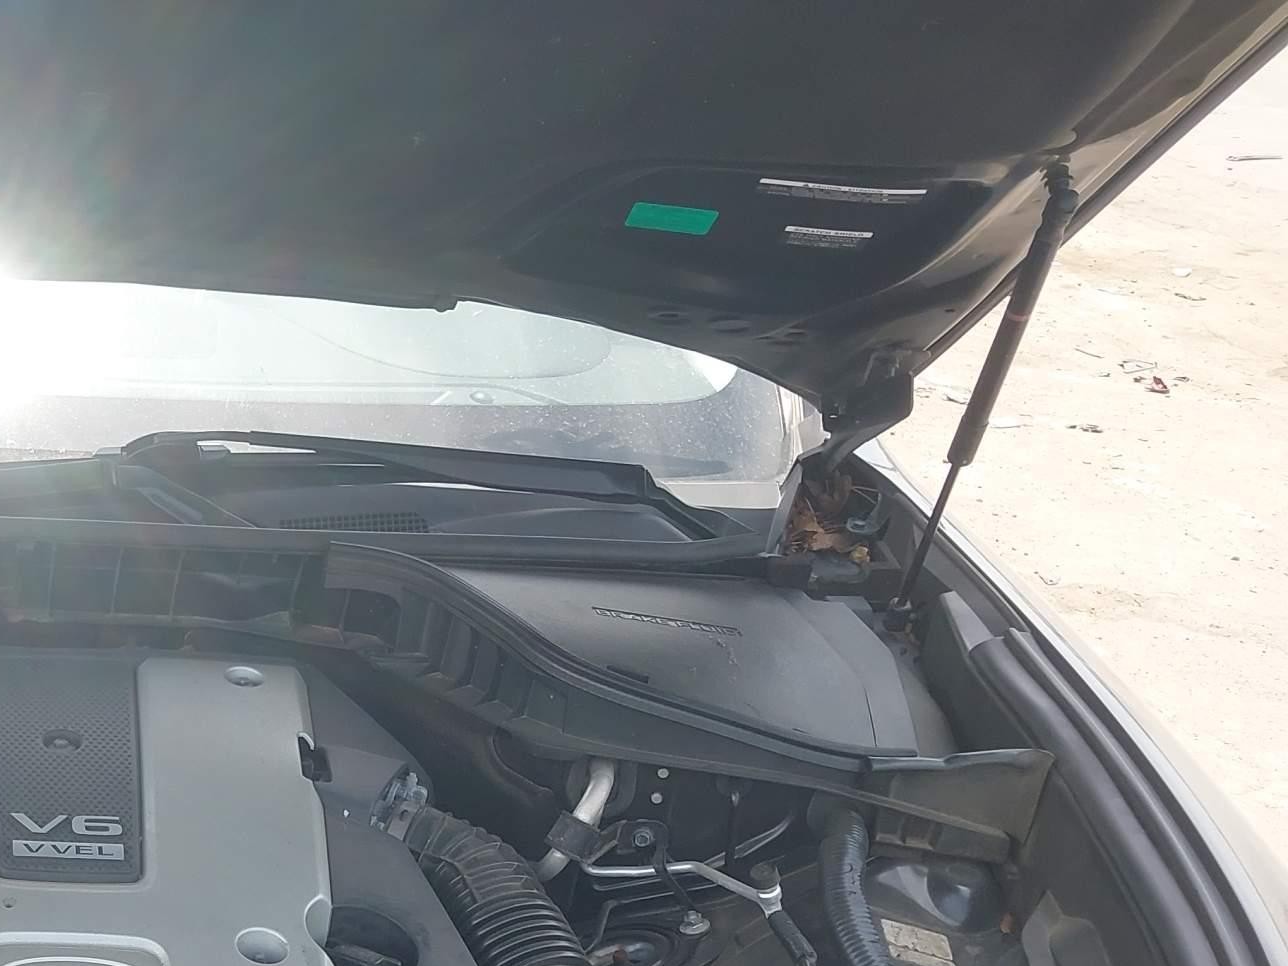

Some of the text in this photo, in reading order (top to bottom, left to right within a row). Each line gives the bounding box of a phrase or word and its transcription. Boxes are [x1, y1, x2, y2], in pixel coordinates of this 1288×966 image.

[593, 608, 738, 637] BRAKE FLUID
[9, 812, 123, 836] V6
[23, 843, 114, 857] VVEL
